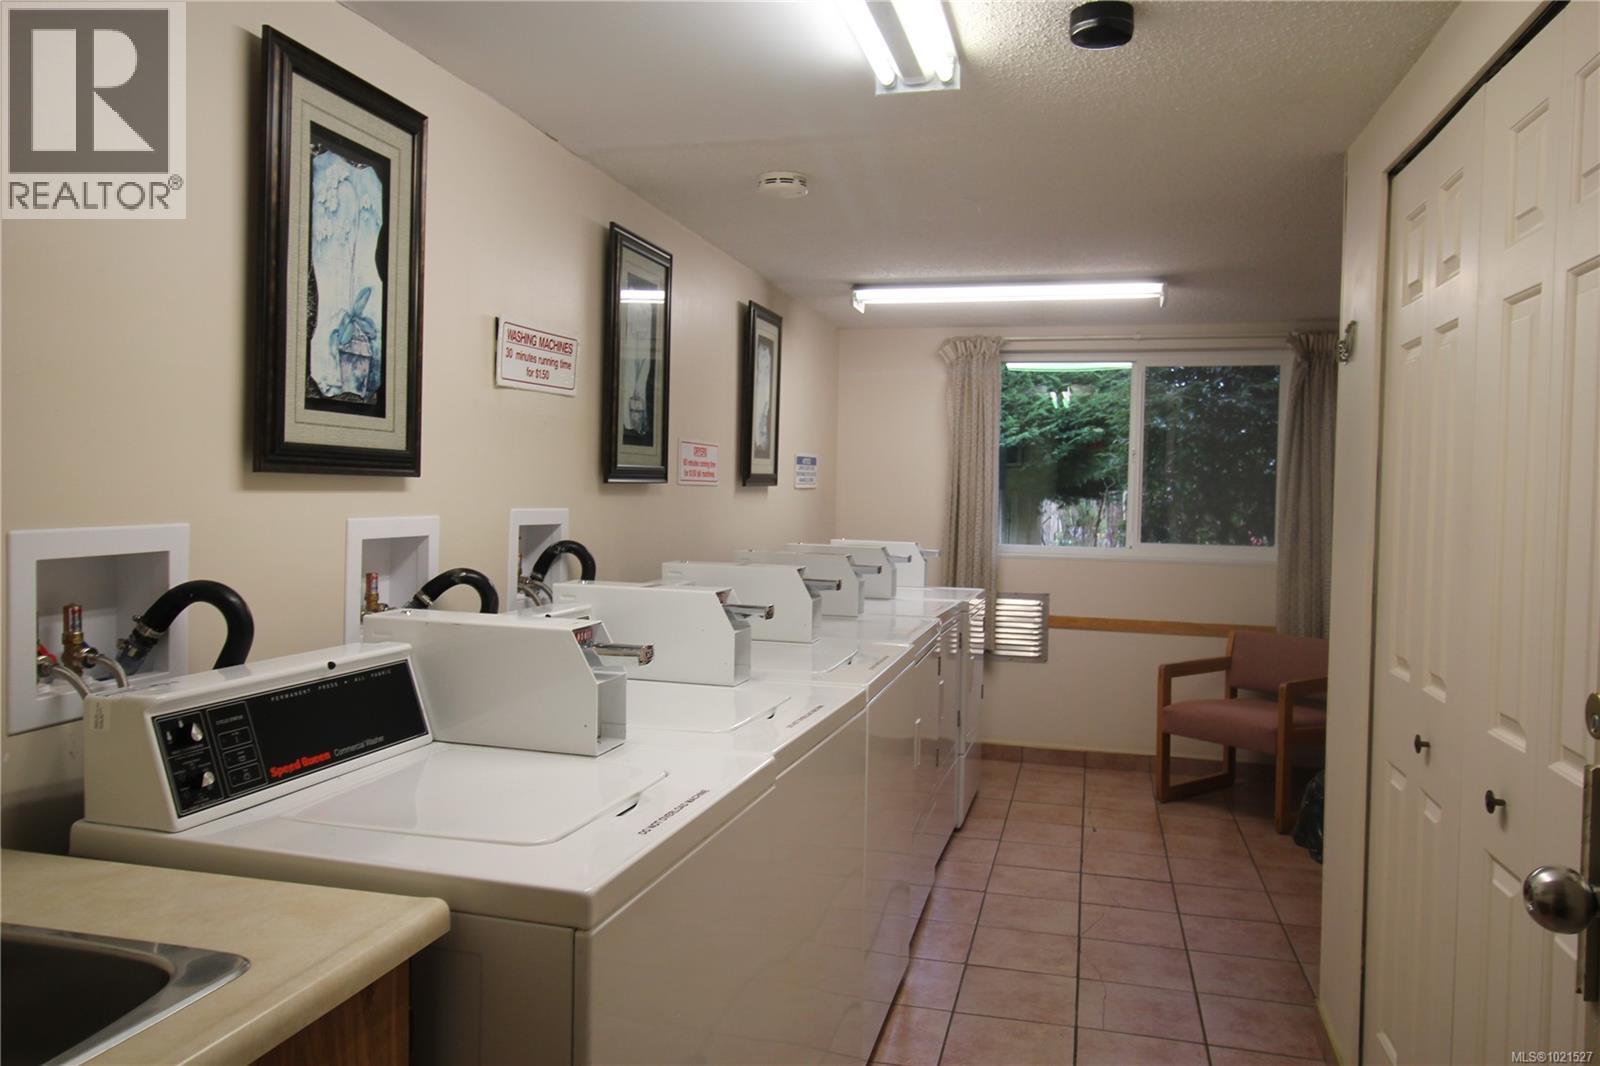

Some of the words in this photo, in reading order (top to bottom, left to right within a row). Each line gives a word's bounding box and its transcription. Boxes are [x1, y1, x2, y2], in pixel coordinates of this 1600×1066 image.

[507, 328, 537, 347] WASHING
[538, 336, 574, 355] MACHINES
[505, 347, 513, 359] 30
[515, 350, 537, 364] minutes
[538, 356, 559, 370] running
[560, 359, 572, 370] time
[526, 367, 535, 378] for
[271, 687, 312, 702] PERMANENT
[270, 757, 301, 778] Speed
[301, 751, 331, 767] Queen
[333, 741, 366, 757] Commercial
